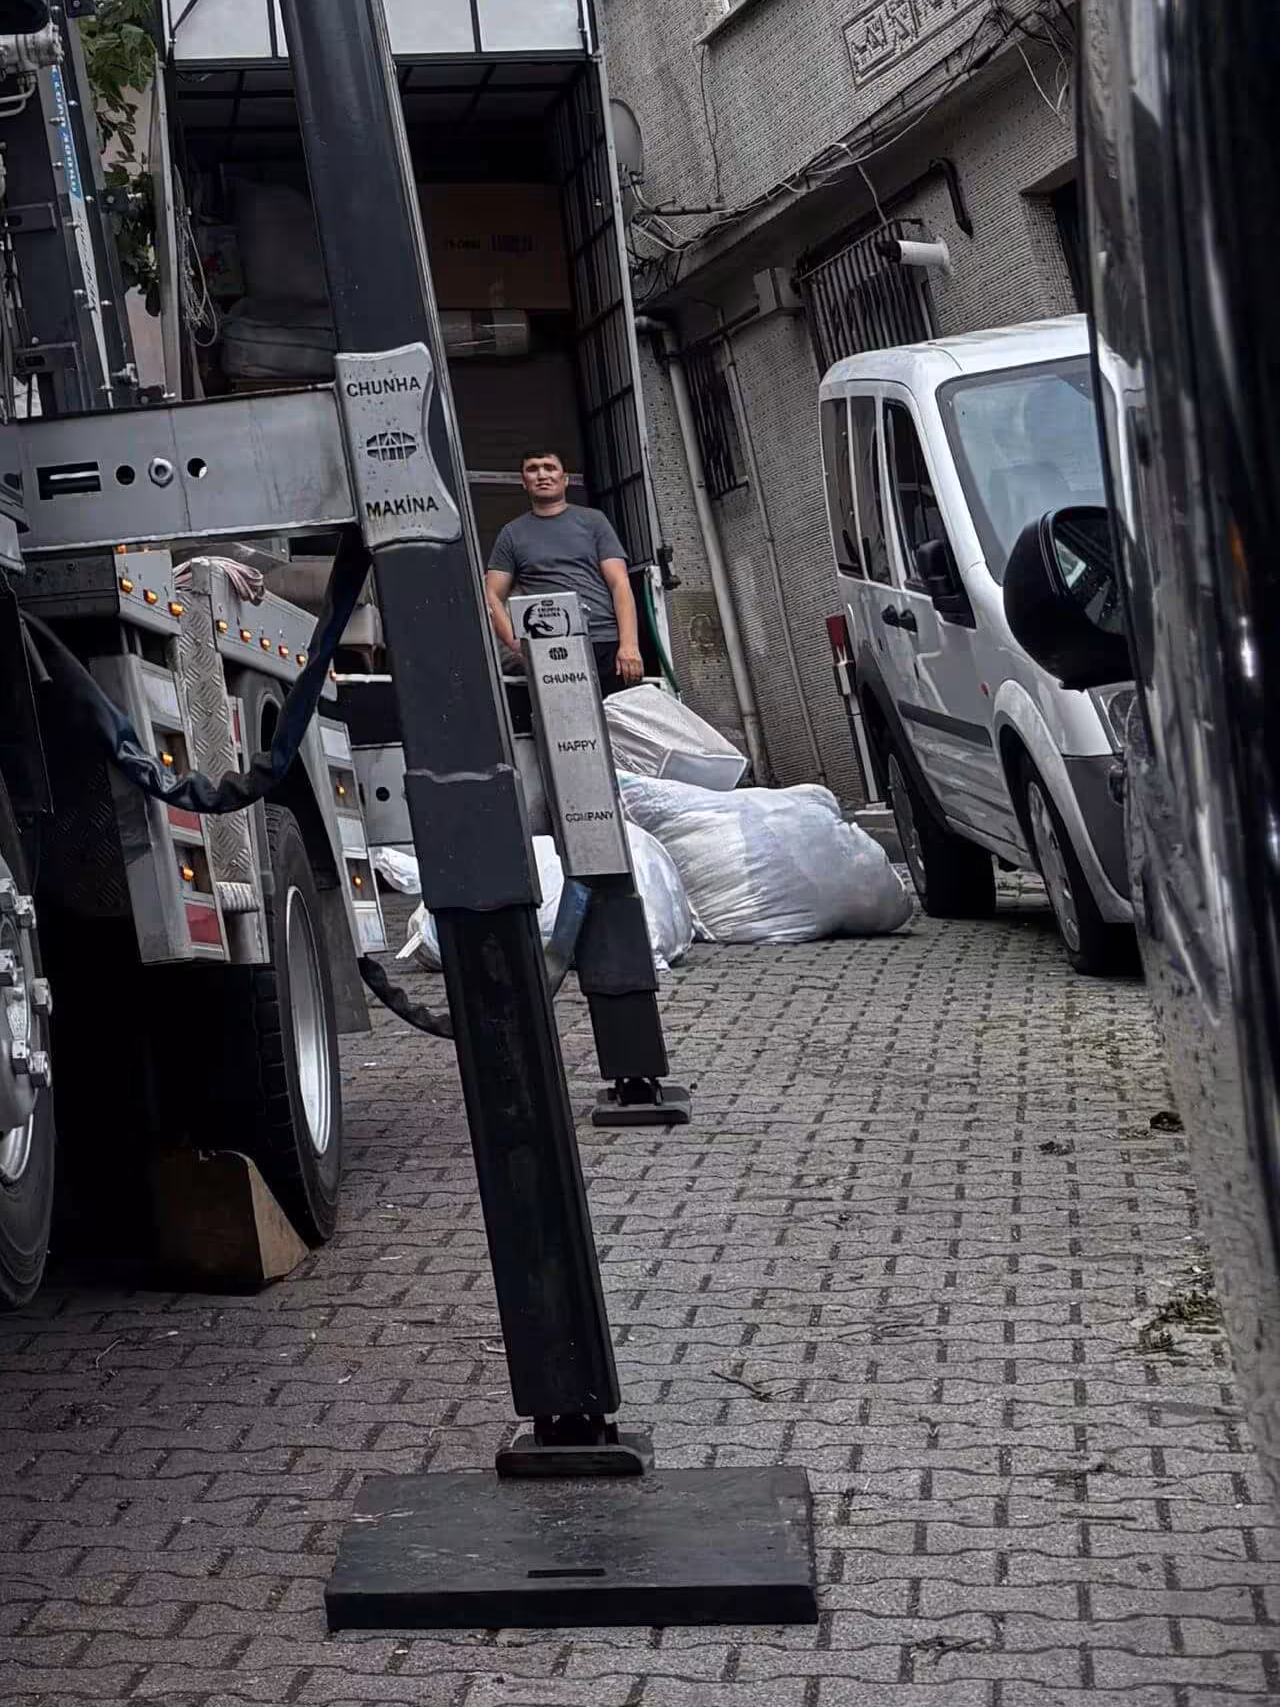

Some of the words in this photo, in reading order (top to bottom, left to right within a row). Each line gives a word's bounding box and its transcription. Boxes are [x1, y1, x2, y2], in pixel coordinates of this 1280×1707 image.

[346, 376, 421, 398] CHUNHA
[366, 494, 439, 520] MAKİNA
[542, 672, 588, 685] CHUNHA
[558, 738, 597, 752] HAPPY
[565, 810, 614, 824] COMPANY
